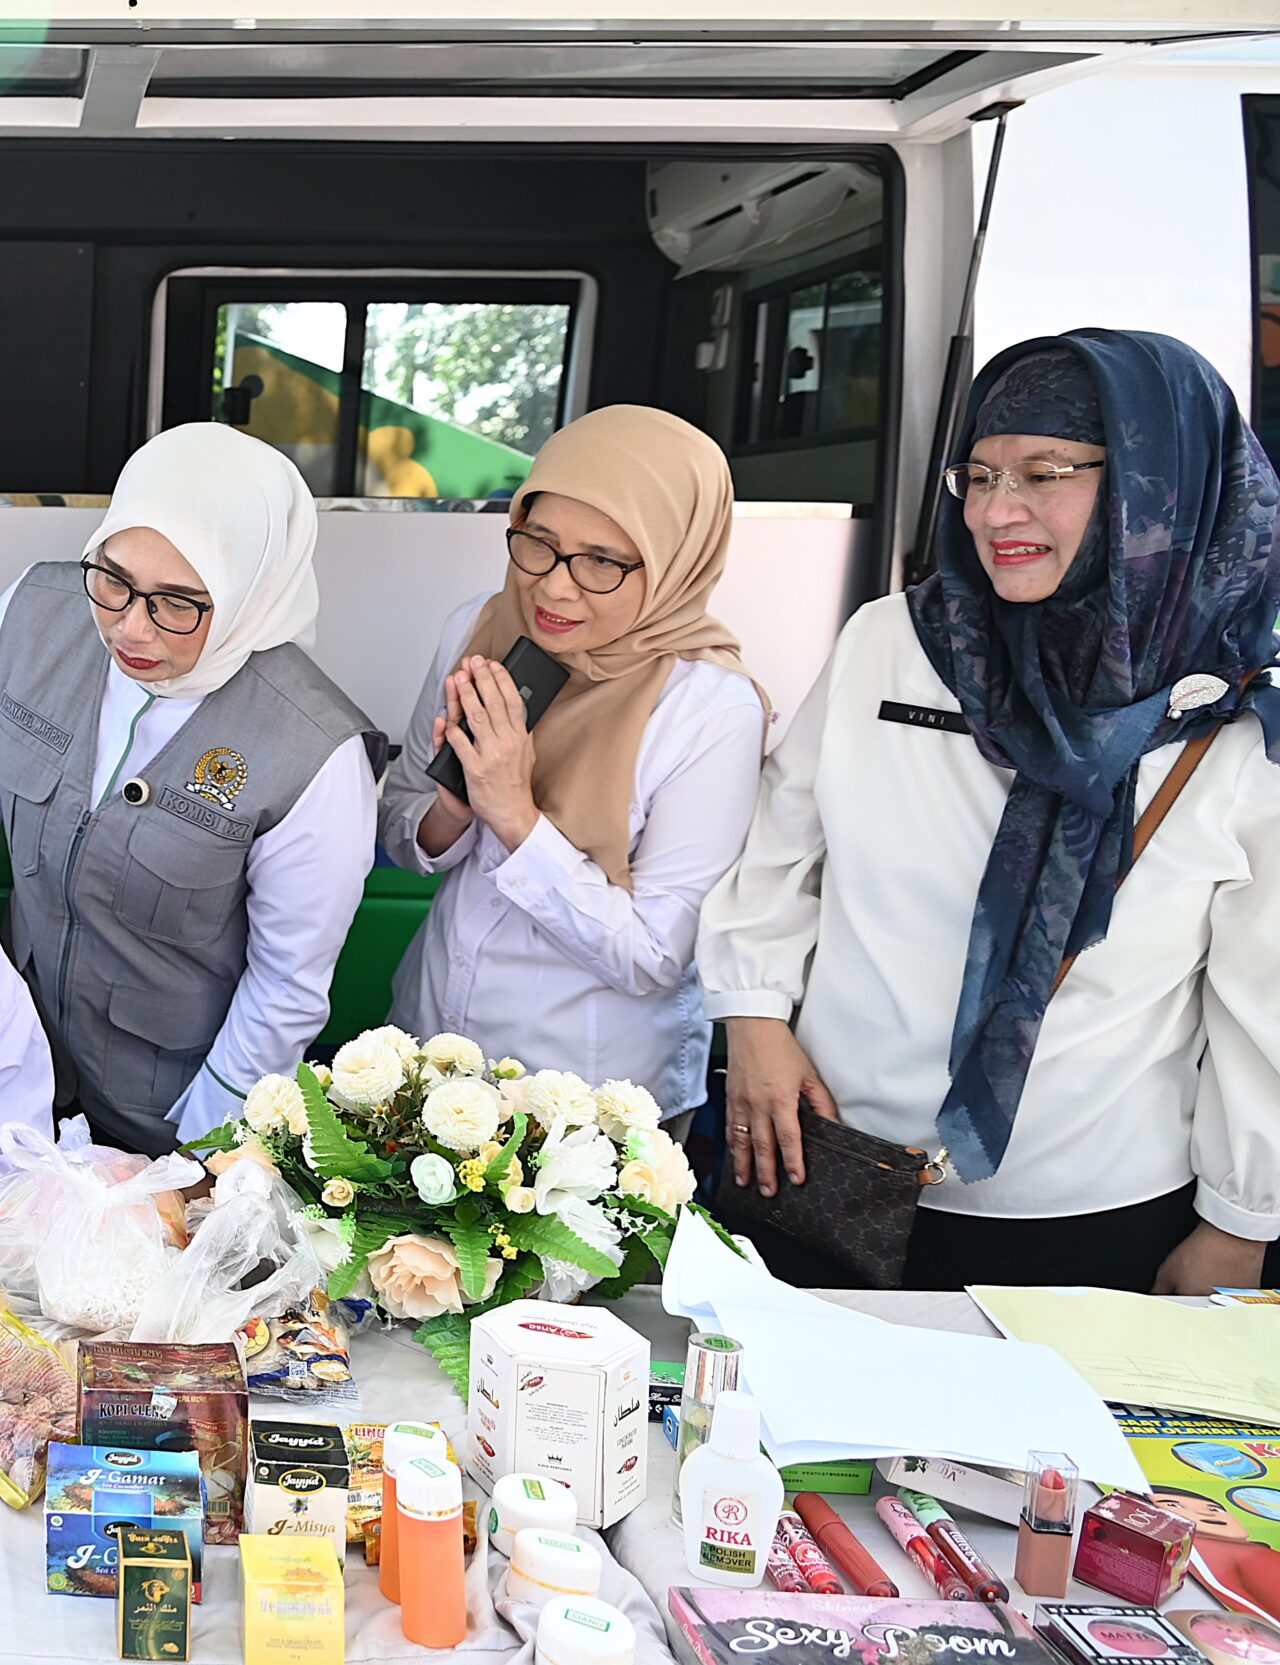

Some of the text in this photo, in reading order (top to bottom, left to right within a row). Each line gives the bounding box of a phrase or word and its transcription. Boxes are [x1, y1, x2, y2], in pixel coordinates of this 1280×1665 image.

[908, 710, 945, 725] VINI
[163, 790, 243, 837] KOMISI IX
[99, 1403, 128, 1418] KOPI
[613, 1397, 640, 1428] سلطان
[1118, 1419, 1162, 1427] SAAT
[1162, 1428, 1240, 1436] OLAHAN
[267, 1433, 325, 1447] Jayyid
[107, 1452, 138, 1465] Jayyid
[79, 1468, 166, 1486] J-Gamat
[282, 1474, 320, 1488] Jayyid
[267, 1519, 336, 1537] J-Misya
[705, 1526, 752, 1546] RIKA
[702, 1552, 752, 1567] REMOVER
[709, 1545, 746, 1559] POLISH
[729, 1620, 855, 1657] Sexy
